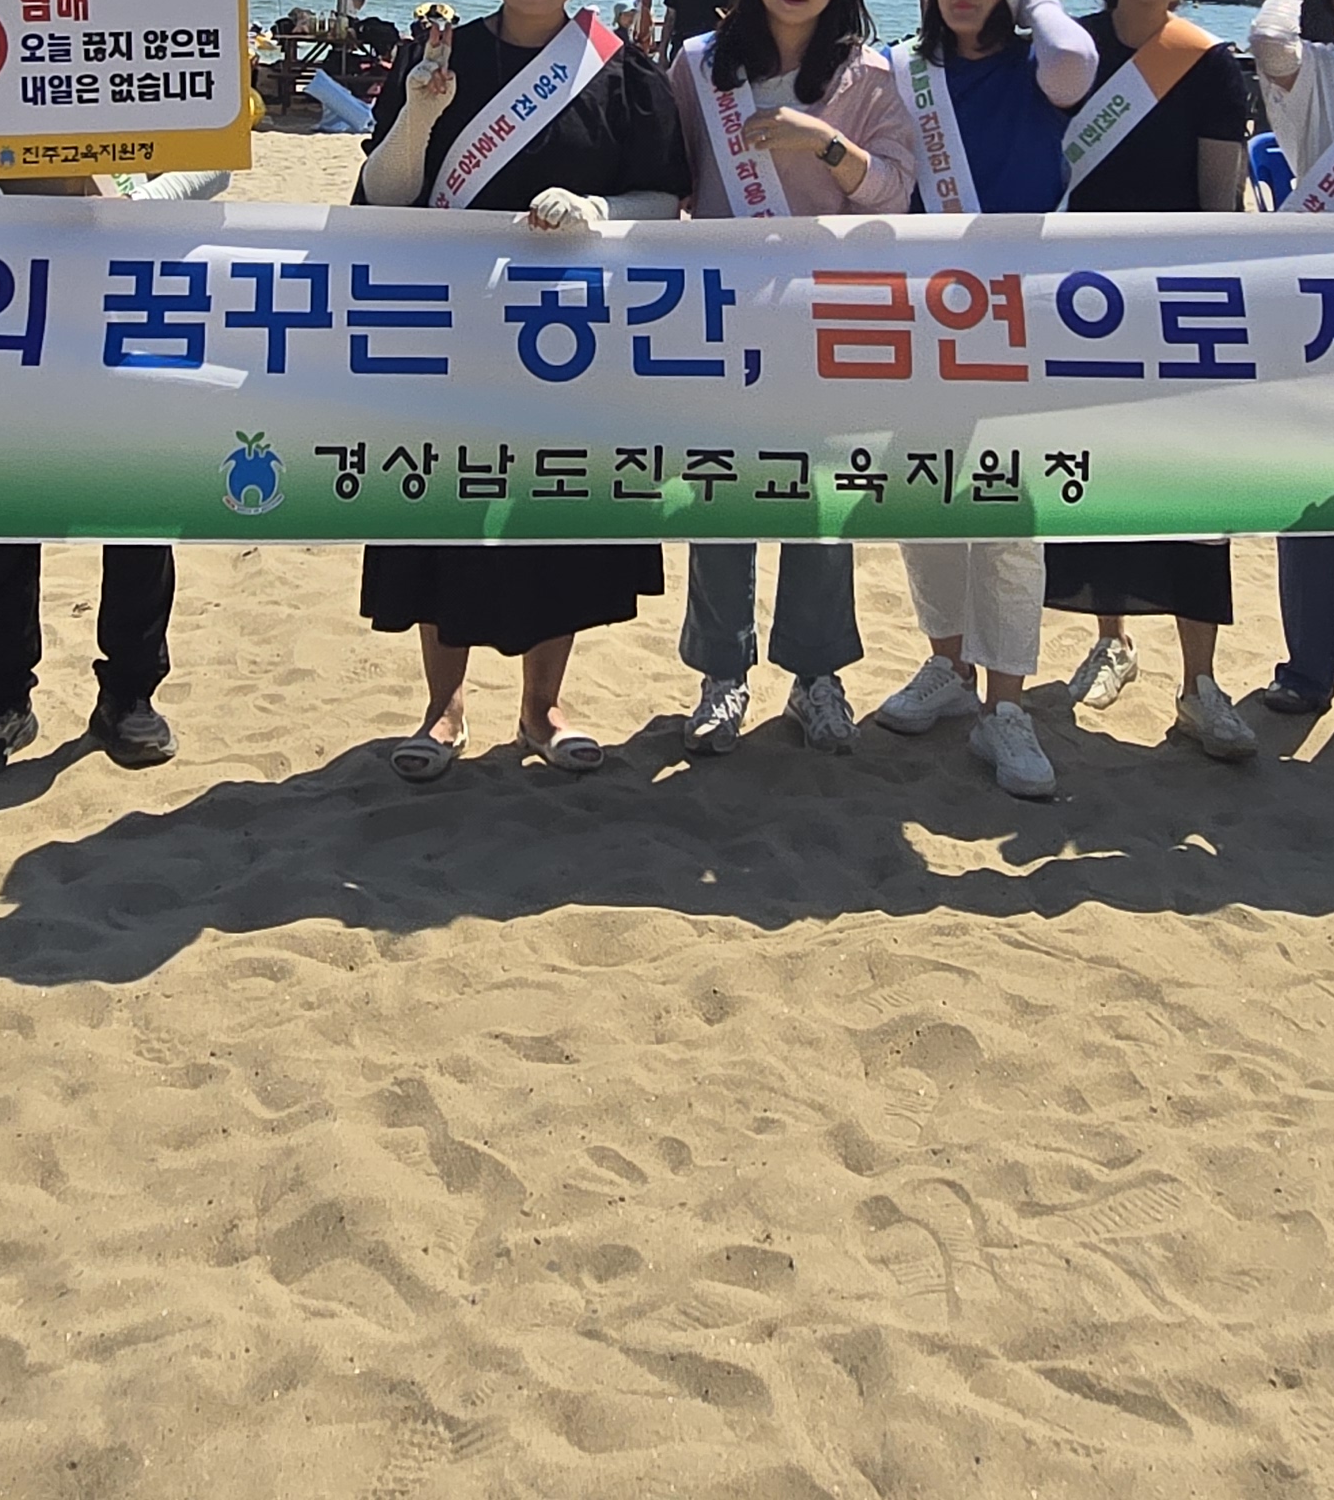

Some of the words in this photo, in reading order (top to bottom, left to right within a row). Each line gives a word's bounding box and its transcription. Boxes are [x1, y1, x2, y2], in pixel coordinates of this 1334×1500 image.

[20, 33, 72, 63] 오늘
[82, 31, 133, 62] 끊지
[143, 28, 221, 61] 않으면
[21, 74, 99, 106] 내일은
[109, 71, 215, 103] 없습니다
[511, 94, 537, 121] 전
[533, 63, 568, 100] 수영
[714, 85, 749, 156] 호장비
[736, 159, 767, 205] 착용
[919, 111, 951, 173] 건강한
[1078, 94, 1131, 147] 안전한
[445, 114, 516, 195] 보호장비
[102, 259, 453, 375] 꿈꾸는
[504, 266, 763, 388] 공간,
[811, 269, 1257, 383] 금연으로
[314, 441, 1091, 505] 경상남도진주교육지원청
